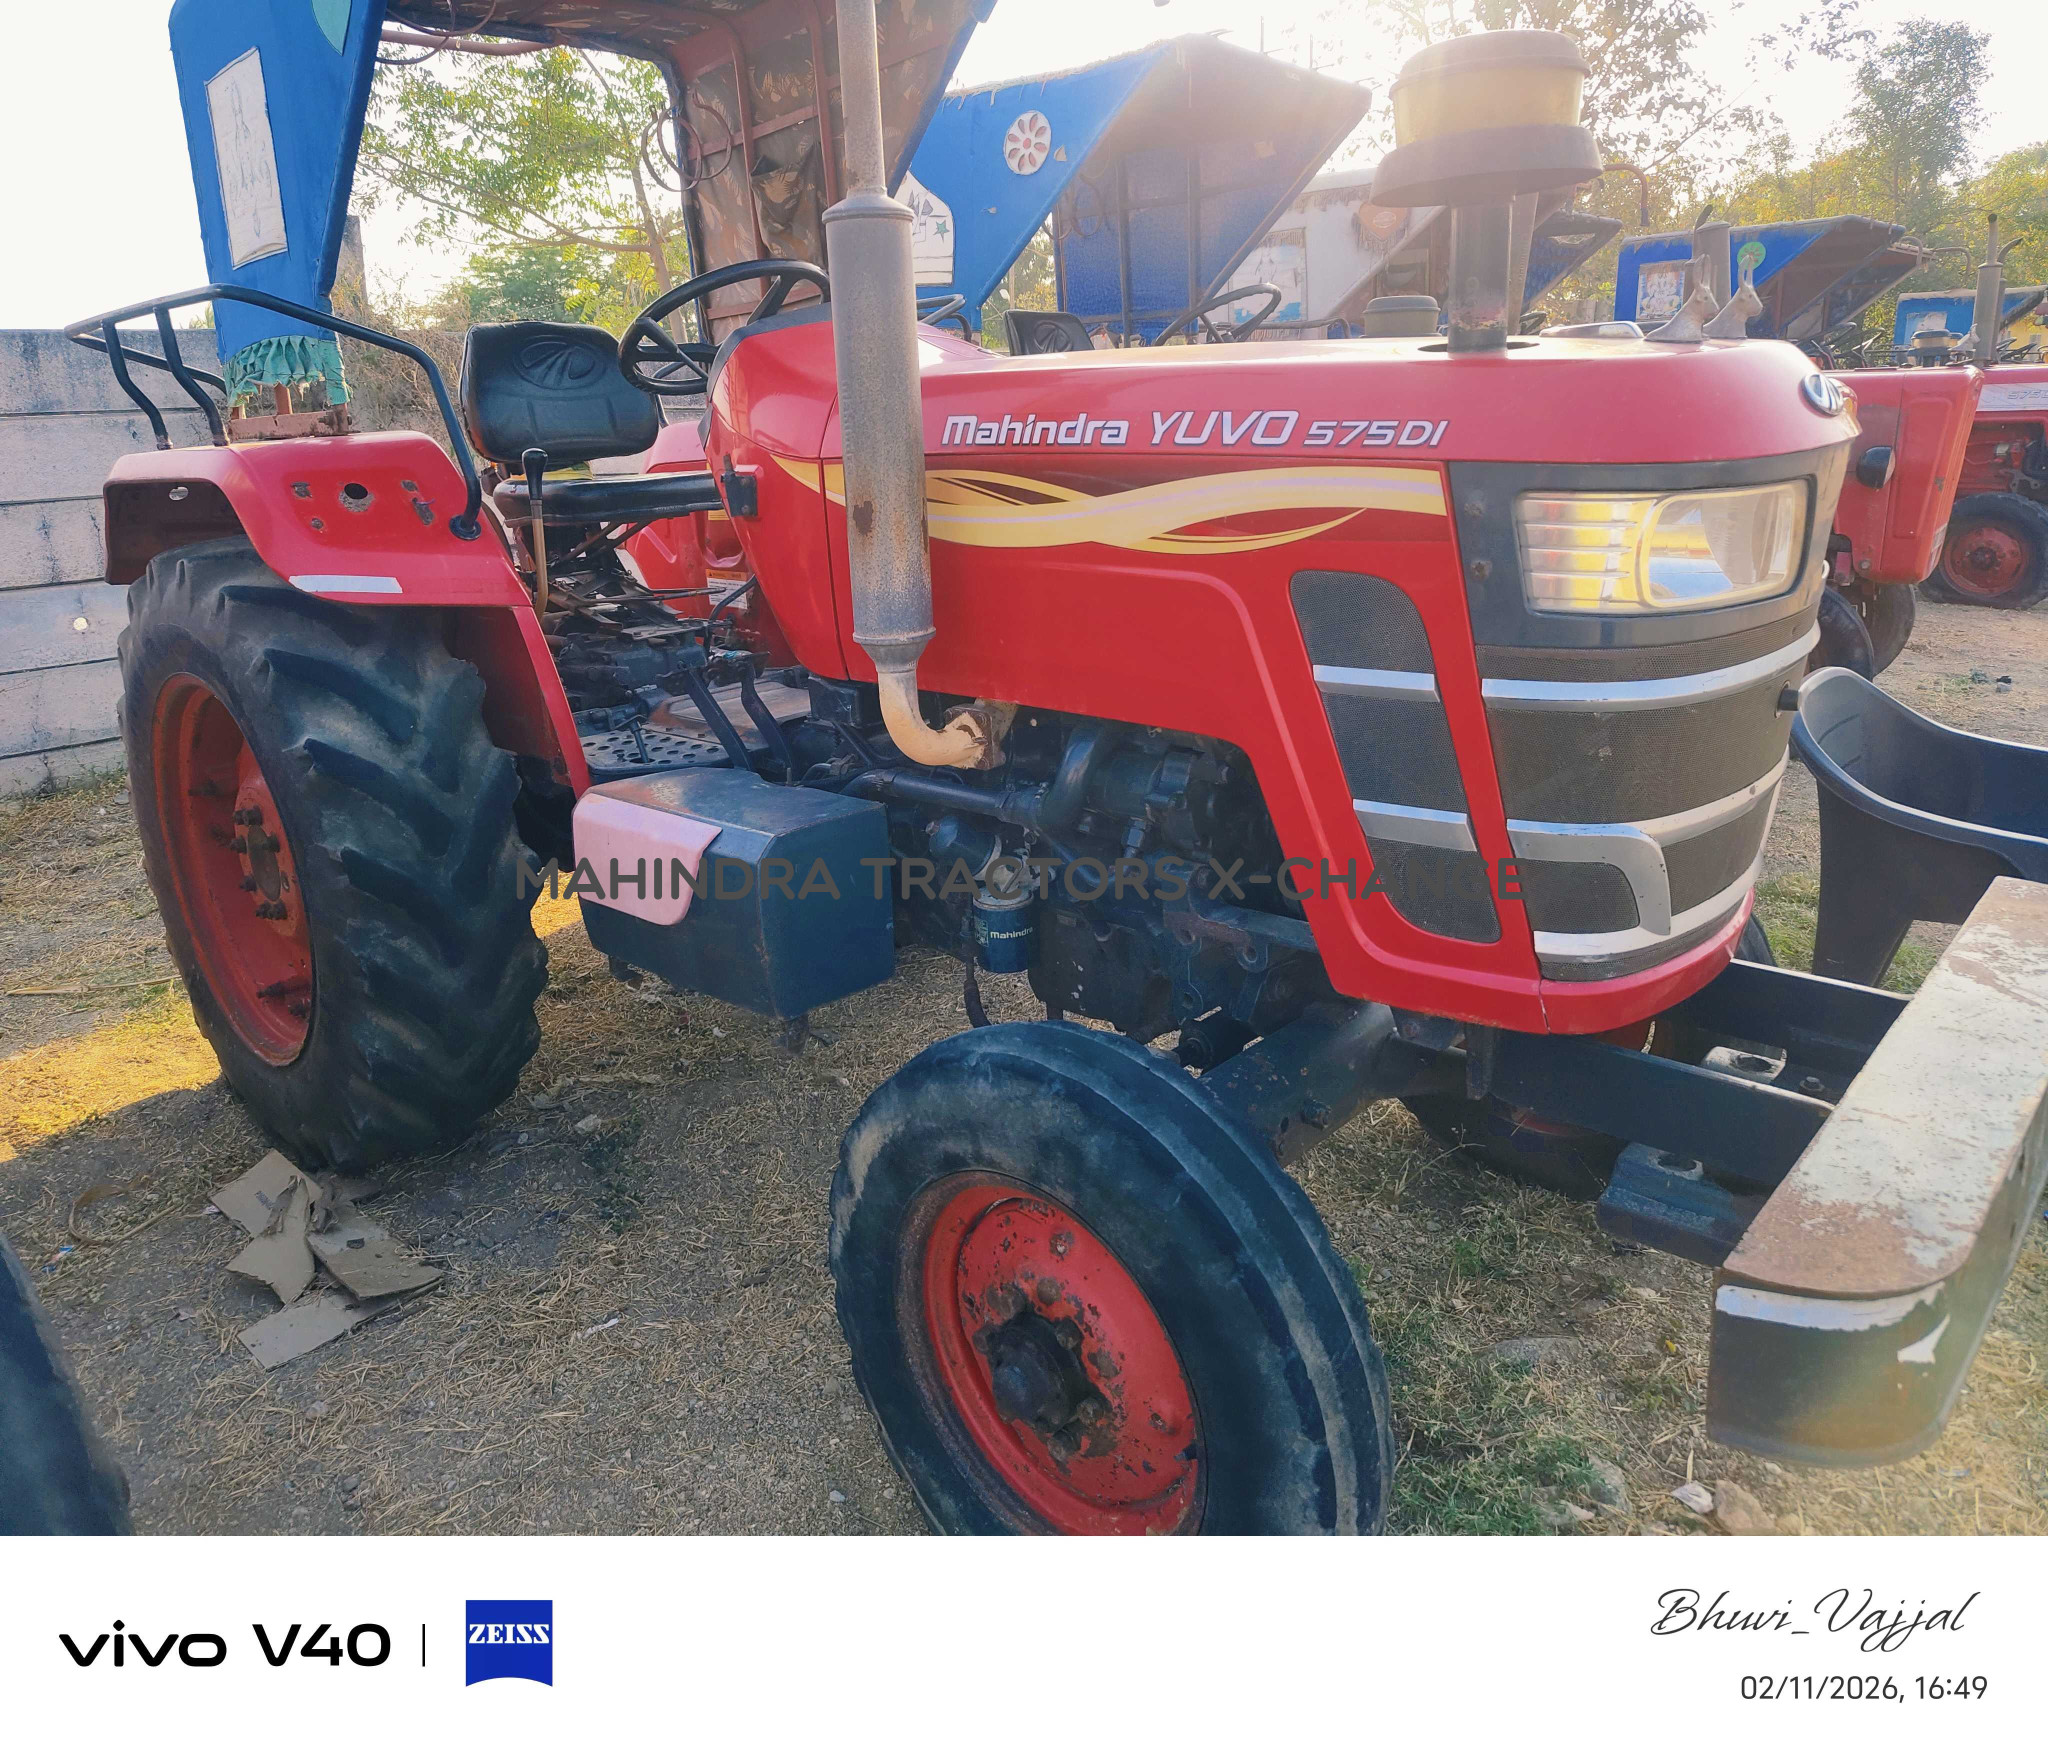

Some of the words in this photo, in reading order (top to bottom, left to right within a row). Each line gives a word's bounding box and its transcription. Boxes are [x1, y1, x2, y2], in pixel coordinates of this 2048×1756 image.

[941, 412, 1130, 446] Mahindra
[1151, 410, 1299, 446] YUVO
[1303, 420, 1449, 447] 575DI
